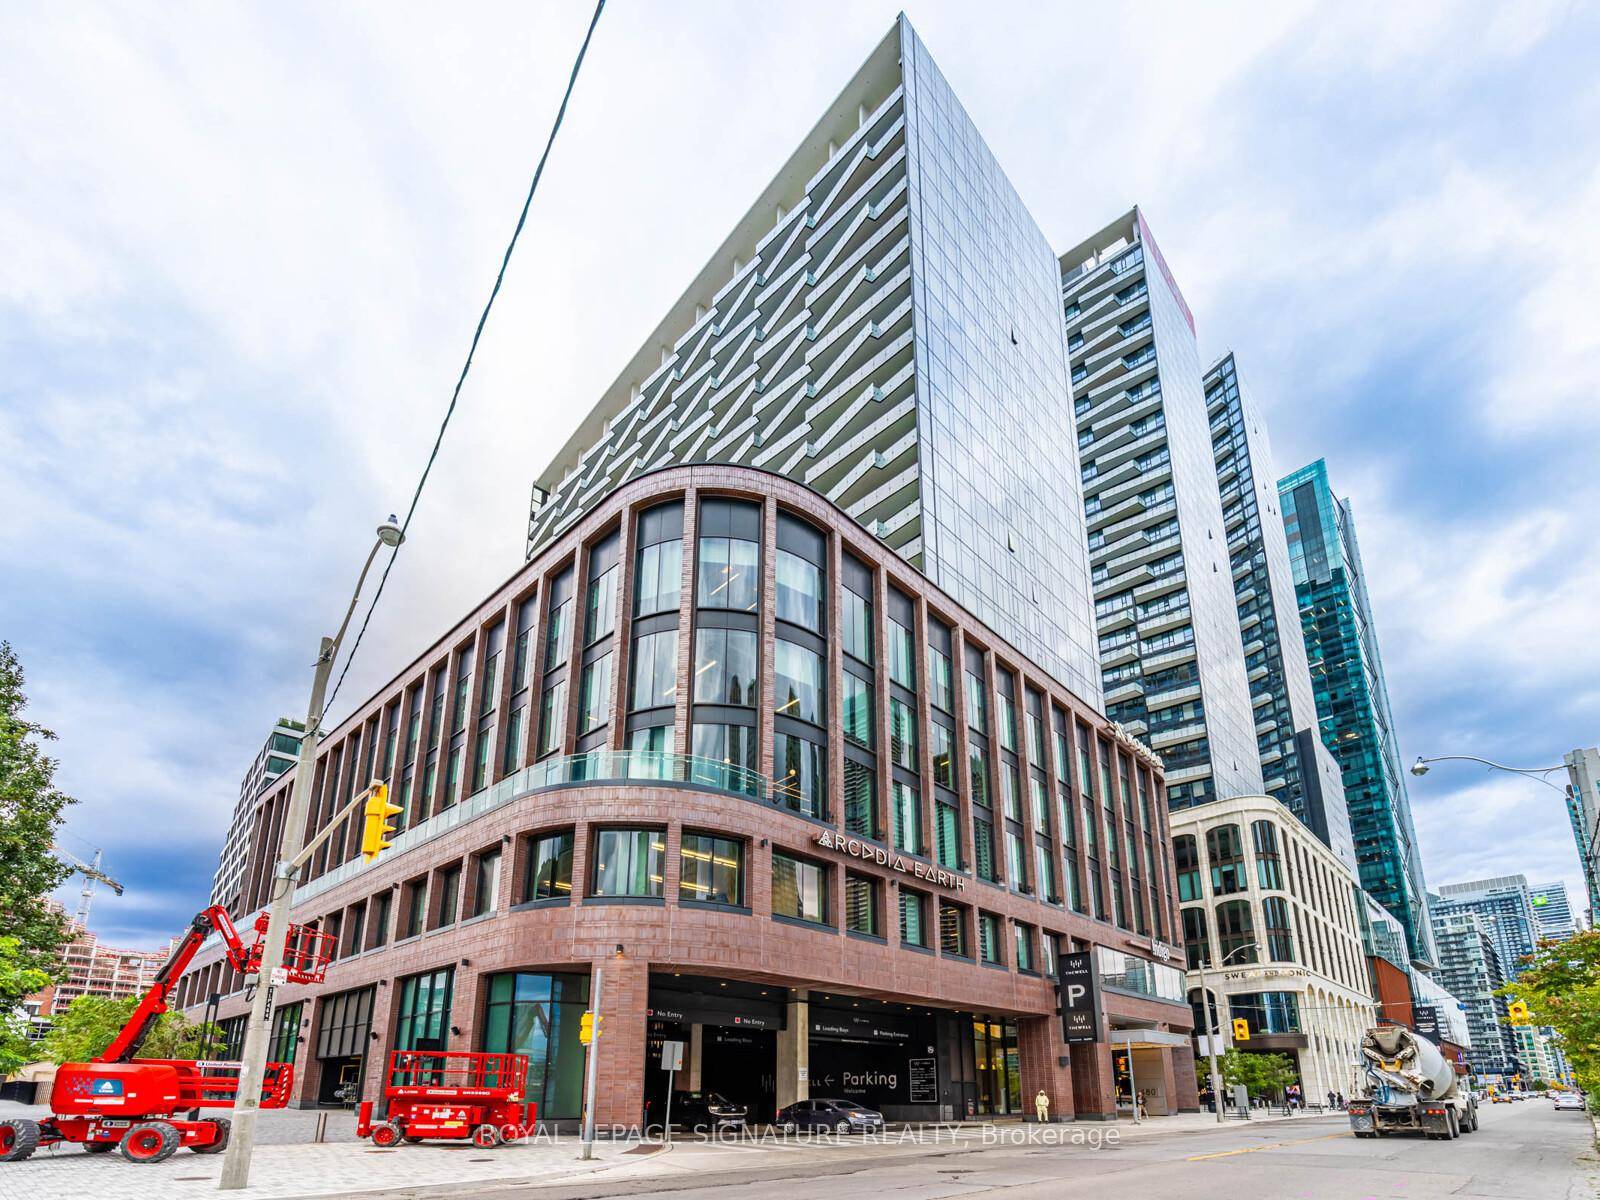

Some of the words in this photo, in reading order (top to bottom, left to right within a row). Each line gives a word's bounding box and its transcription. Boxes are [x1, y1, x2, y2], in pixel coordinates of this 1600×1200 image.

[818, 830, 907, 873] ARCADIA
[914, 861, 966, 892] EARTH
[1281, 969, 1311, 977] ONIC
[1068, 984, 1086, 1008] P
[667, 1011, 683, 1020] Entry
[752, 1019, 765, 1027] Entry
[843, 1071, 897, 1089] Parking
